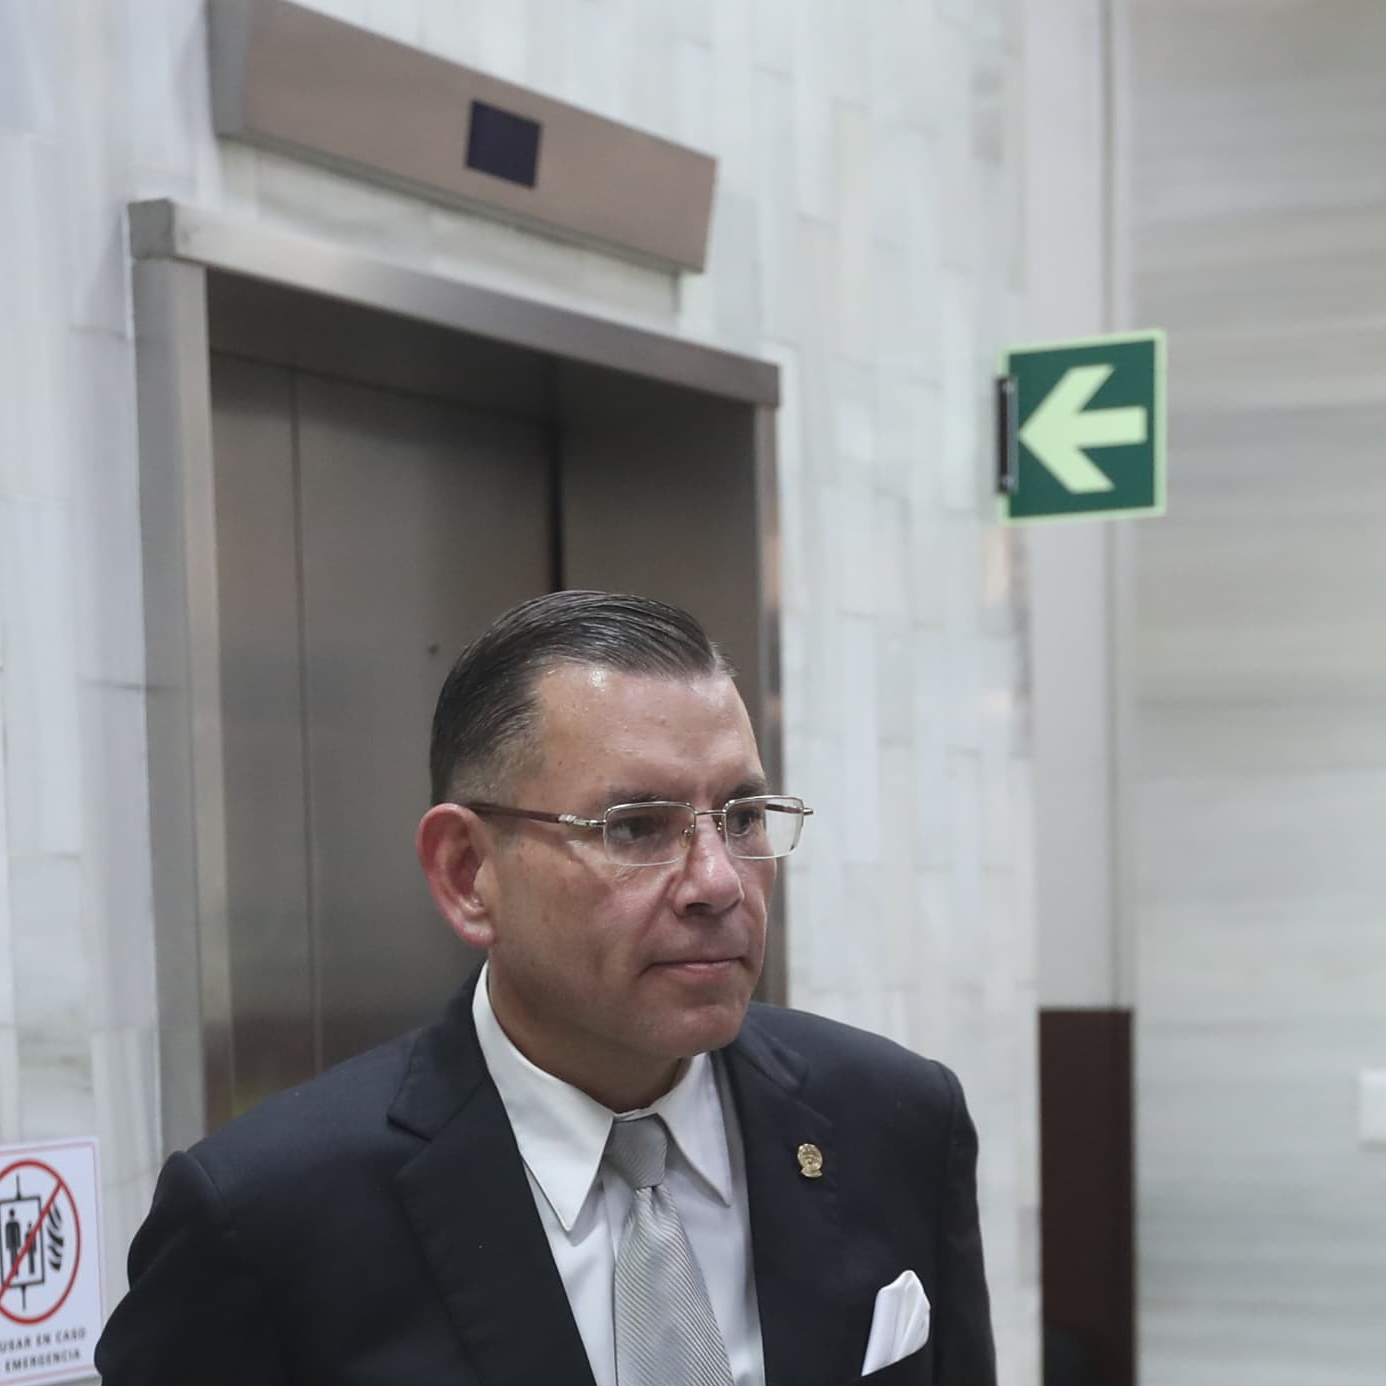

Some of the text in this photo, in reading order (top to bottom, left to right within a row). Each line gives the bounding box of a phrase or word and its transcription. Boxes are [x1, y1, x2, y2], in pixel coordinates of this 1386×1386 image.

[0, 1336, 31, 1352] USAR
[35, 1332, 52, 1347] EN
[55, 1327, 86, 1344] CASO
[4, 1348, 81, 1373] EMERGENCIA
